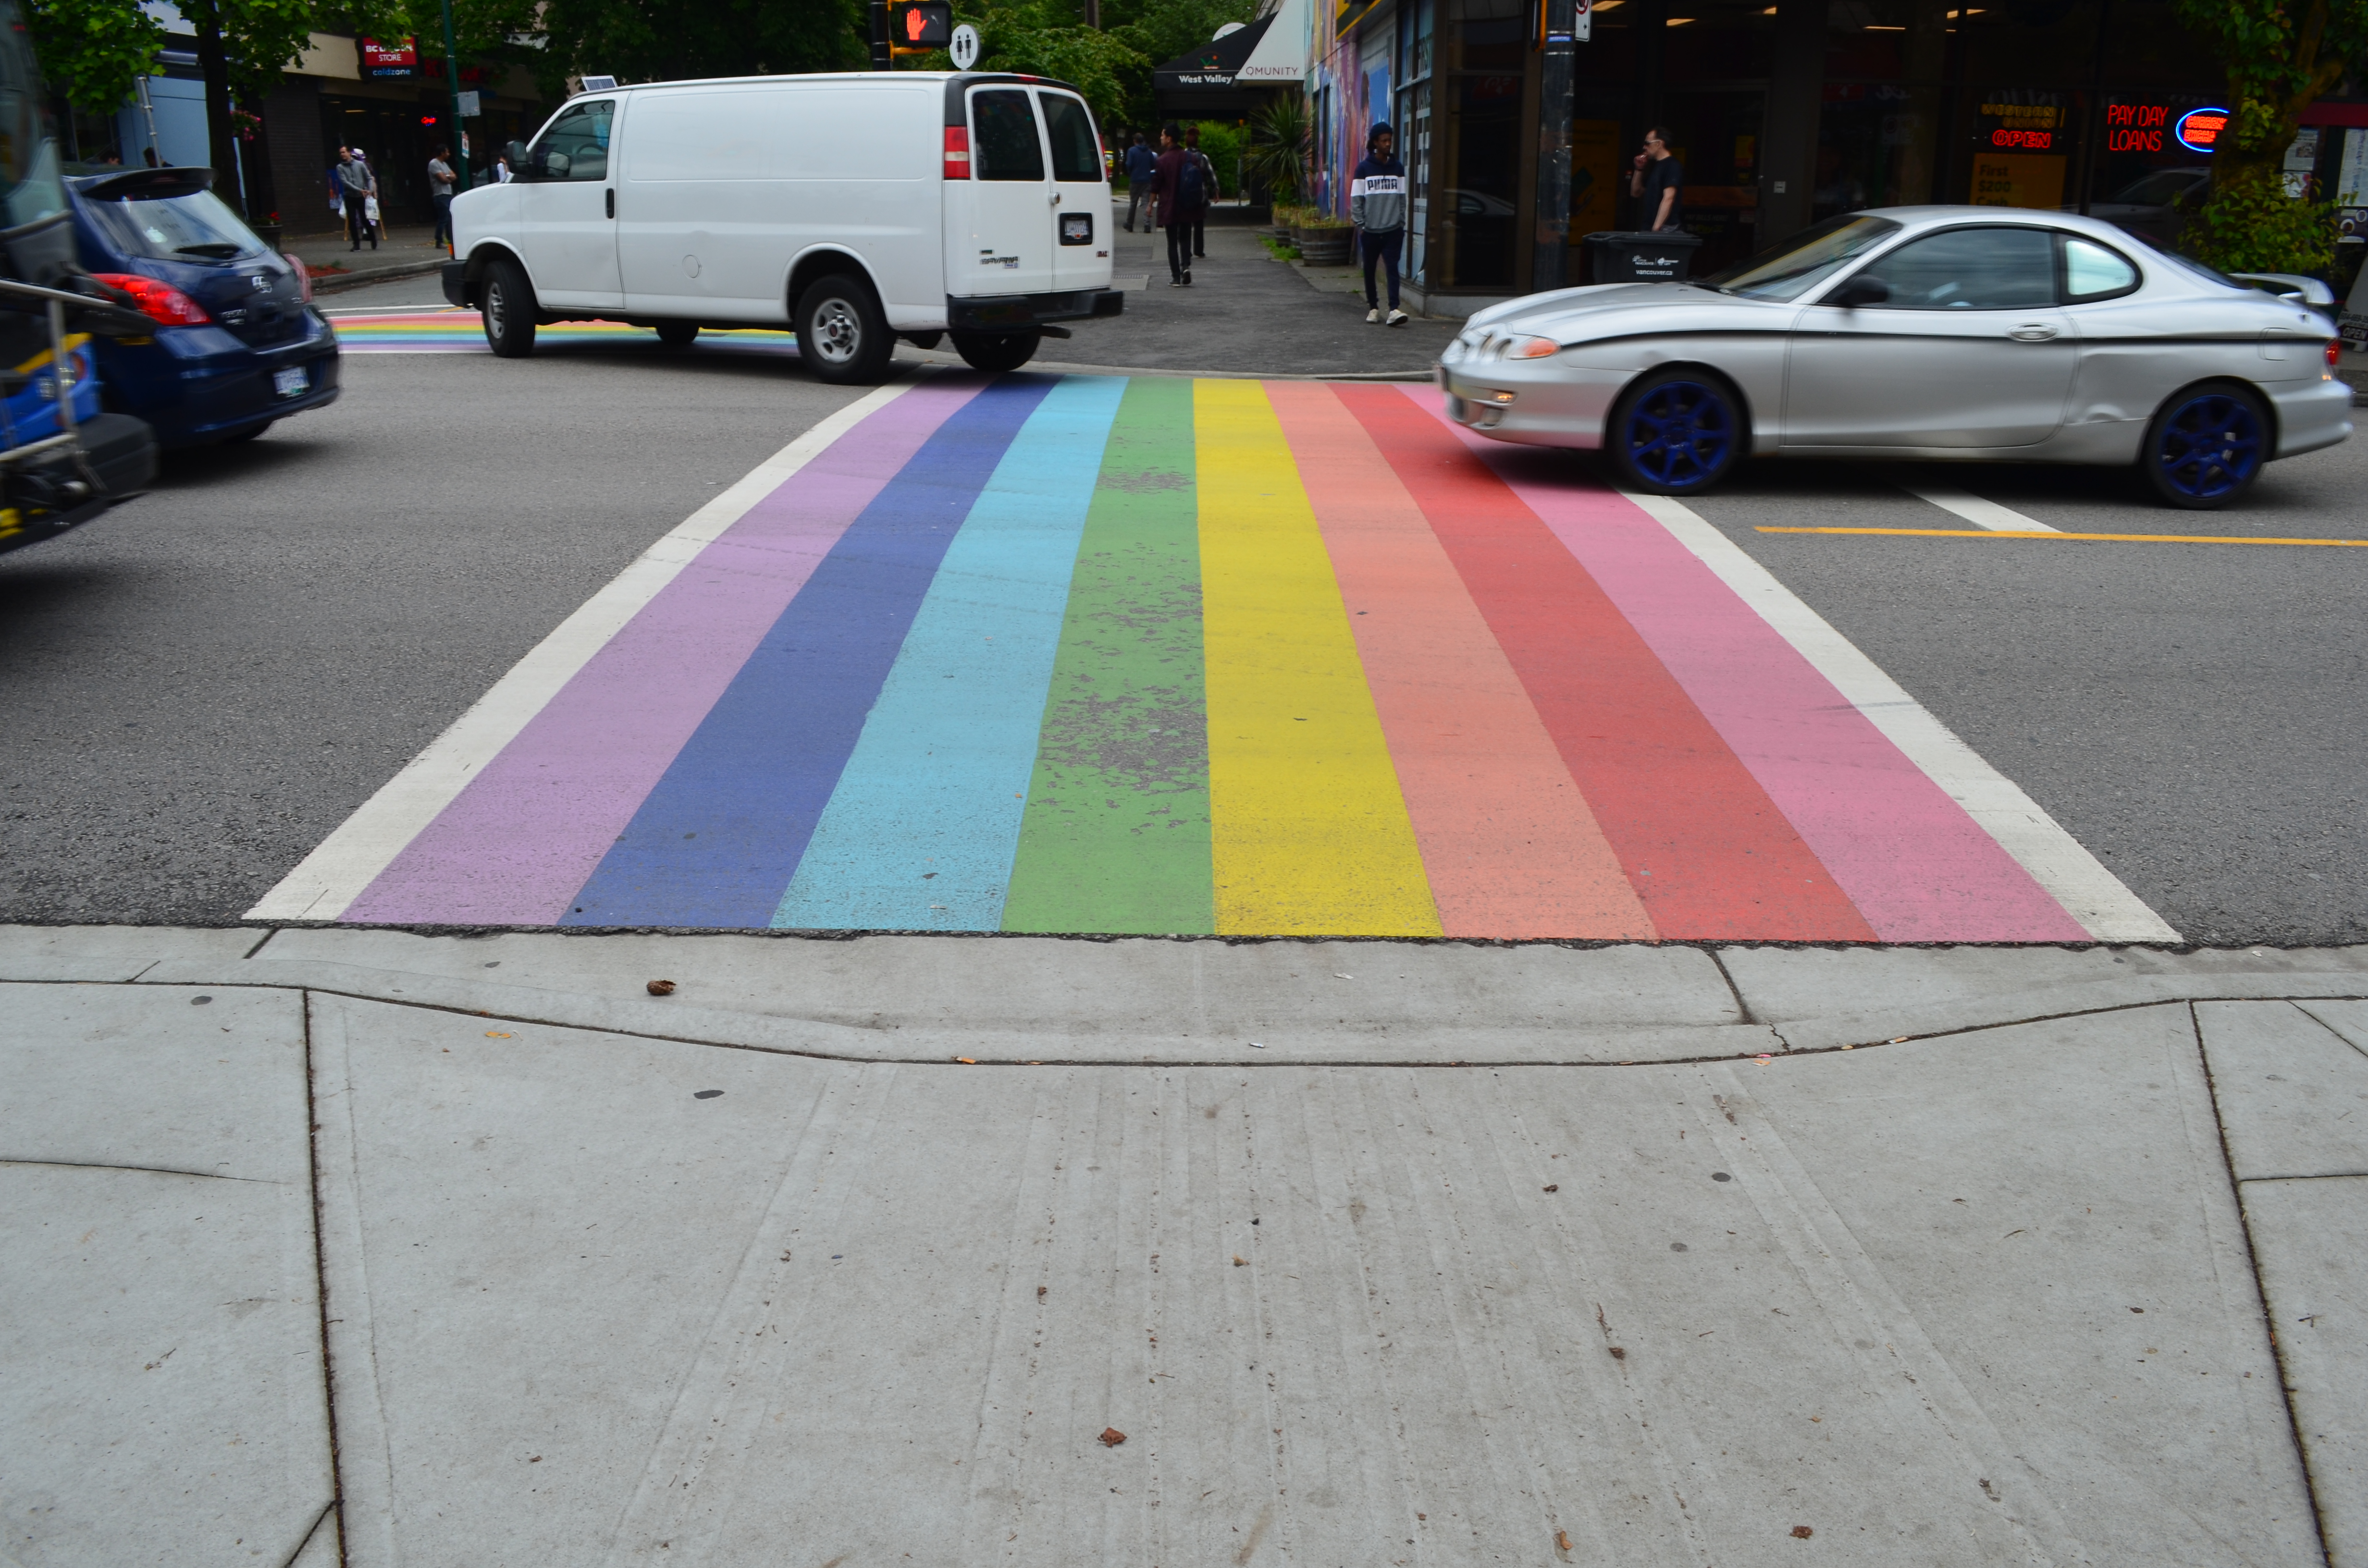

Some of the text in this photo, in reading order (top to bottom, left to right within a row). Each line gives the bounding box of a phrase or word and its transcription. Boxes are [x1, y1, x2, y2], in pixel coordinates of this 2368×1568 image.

[1246, 66, 1298, 76] QMUNITY
[1179, 74, 1233, 84] West Valley
[1982, 104, 2054, 117] WESTERN
[2108, 105, 2169, 126] PAY DAY
[2002, 117, 2053, 128] UNION
[2185, 115, 2228, 130] CURREN
[1992, 129, 2051, 148] OPEN
[2109, 130, 2162, 151] LOANS
[1979, 164, 2008, 177] First
[1367, 179, 1397, 190] PUMA
[1978, 180, 2011, 192] $200
[2342, 327, 2368, 340] OPEN
